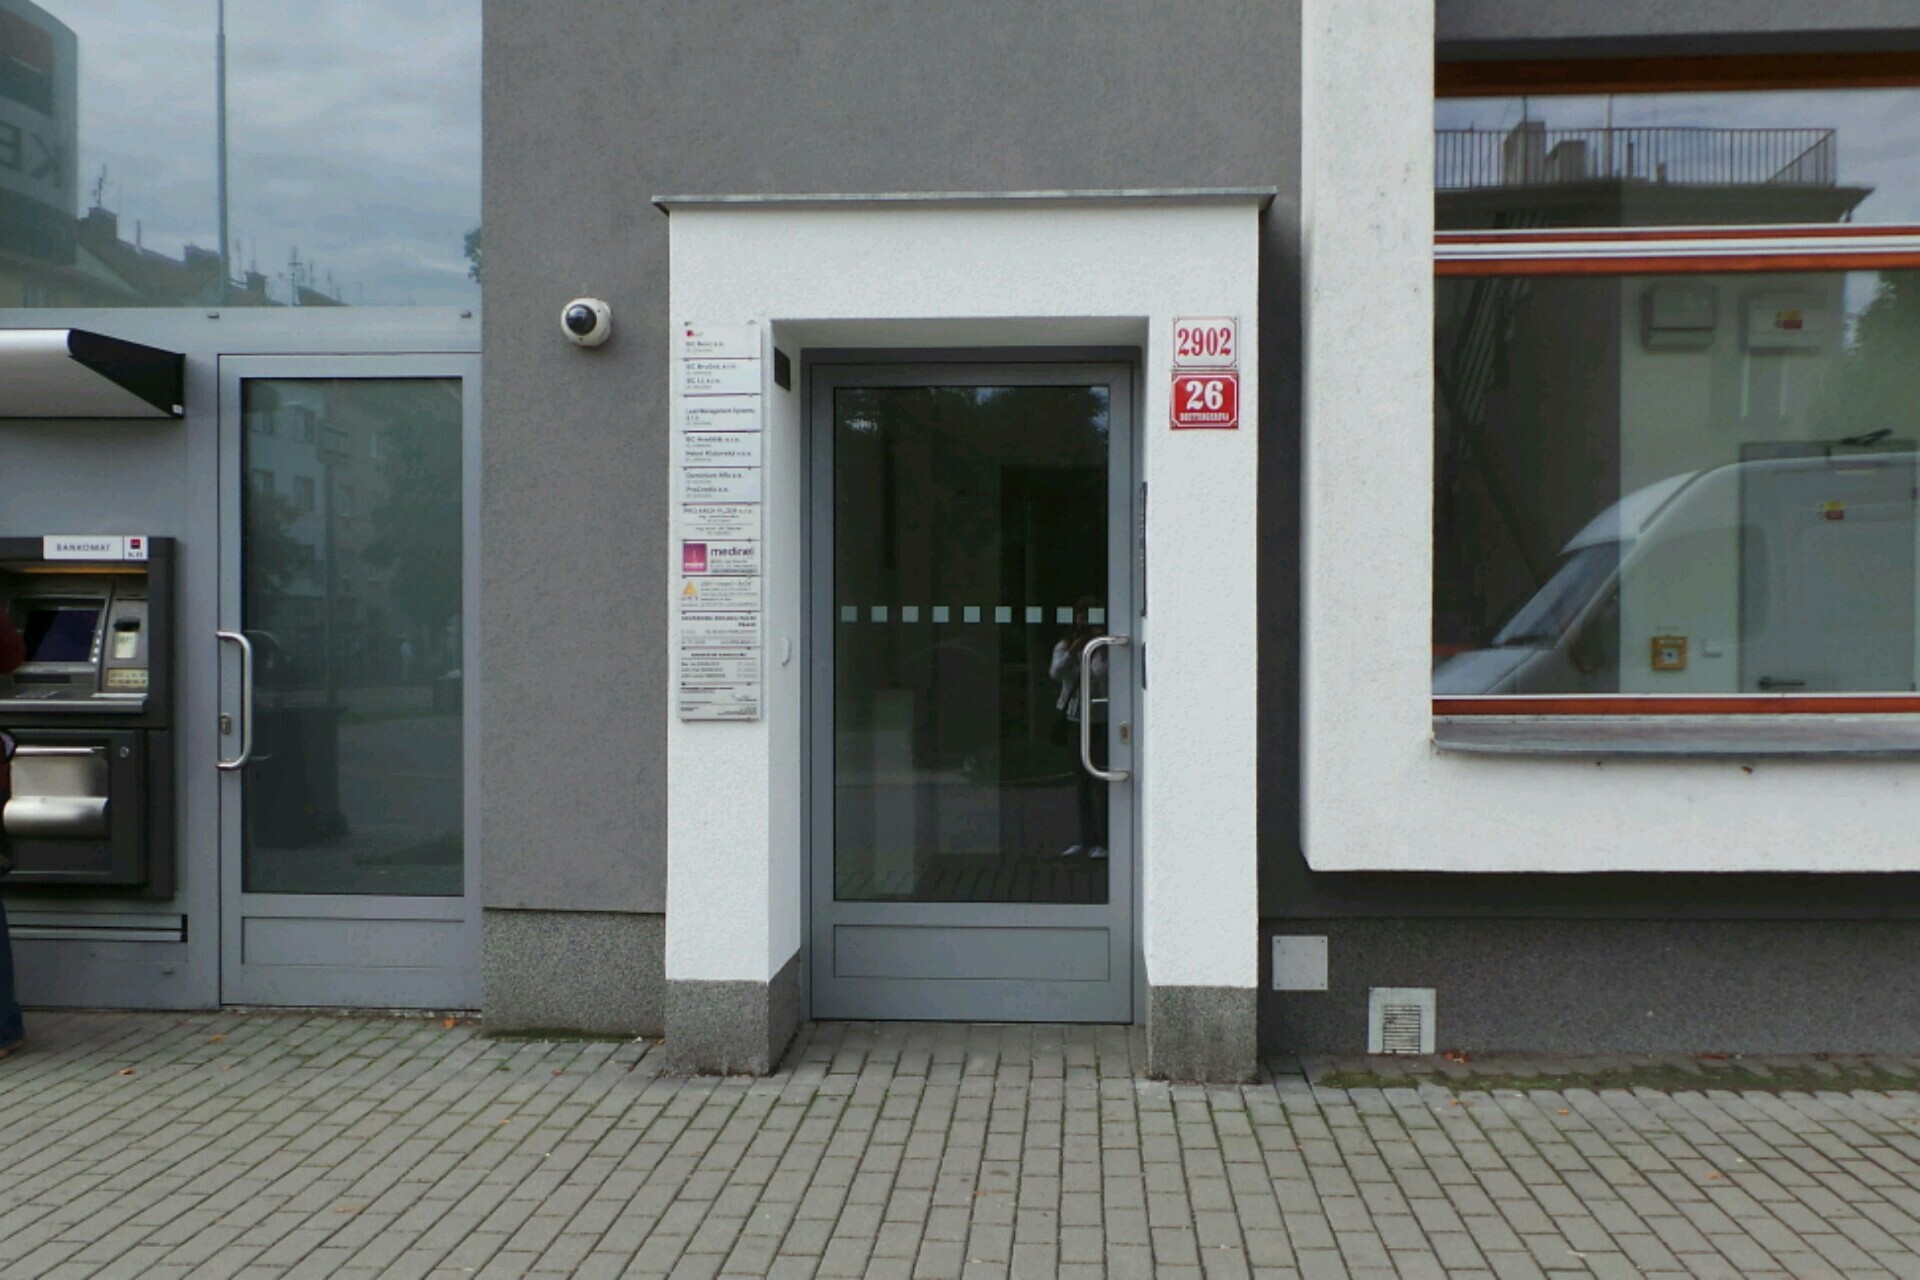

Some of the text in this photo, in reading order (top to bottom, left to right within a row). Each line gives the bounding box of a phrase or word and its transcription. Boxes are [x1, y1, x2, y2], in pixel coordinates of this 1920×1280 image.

[1177, 327, 1232, 356] 2902
[1186, 380, 1223, 410] 26
[56, 543, 110, 552] BANKOMAT
